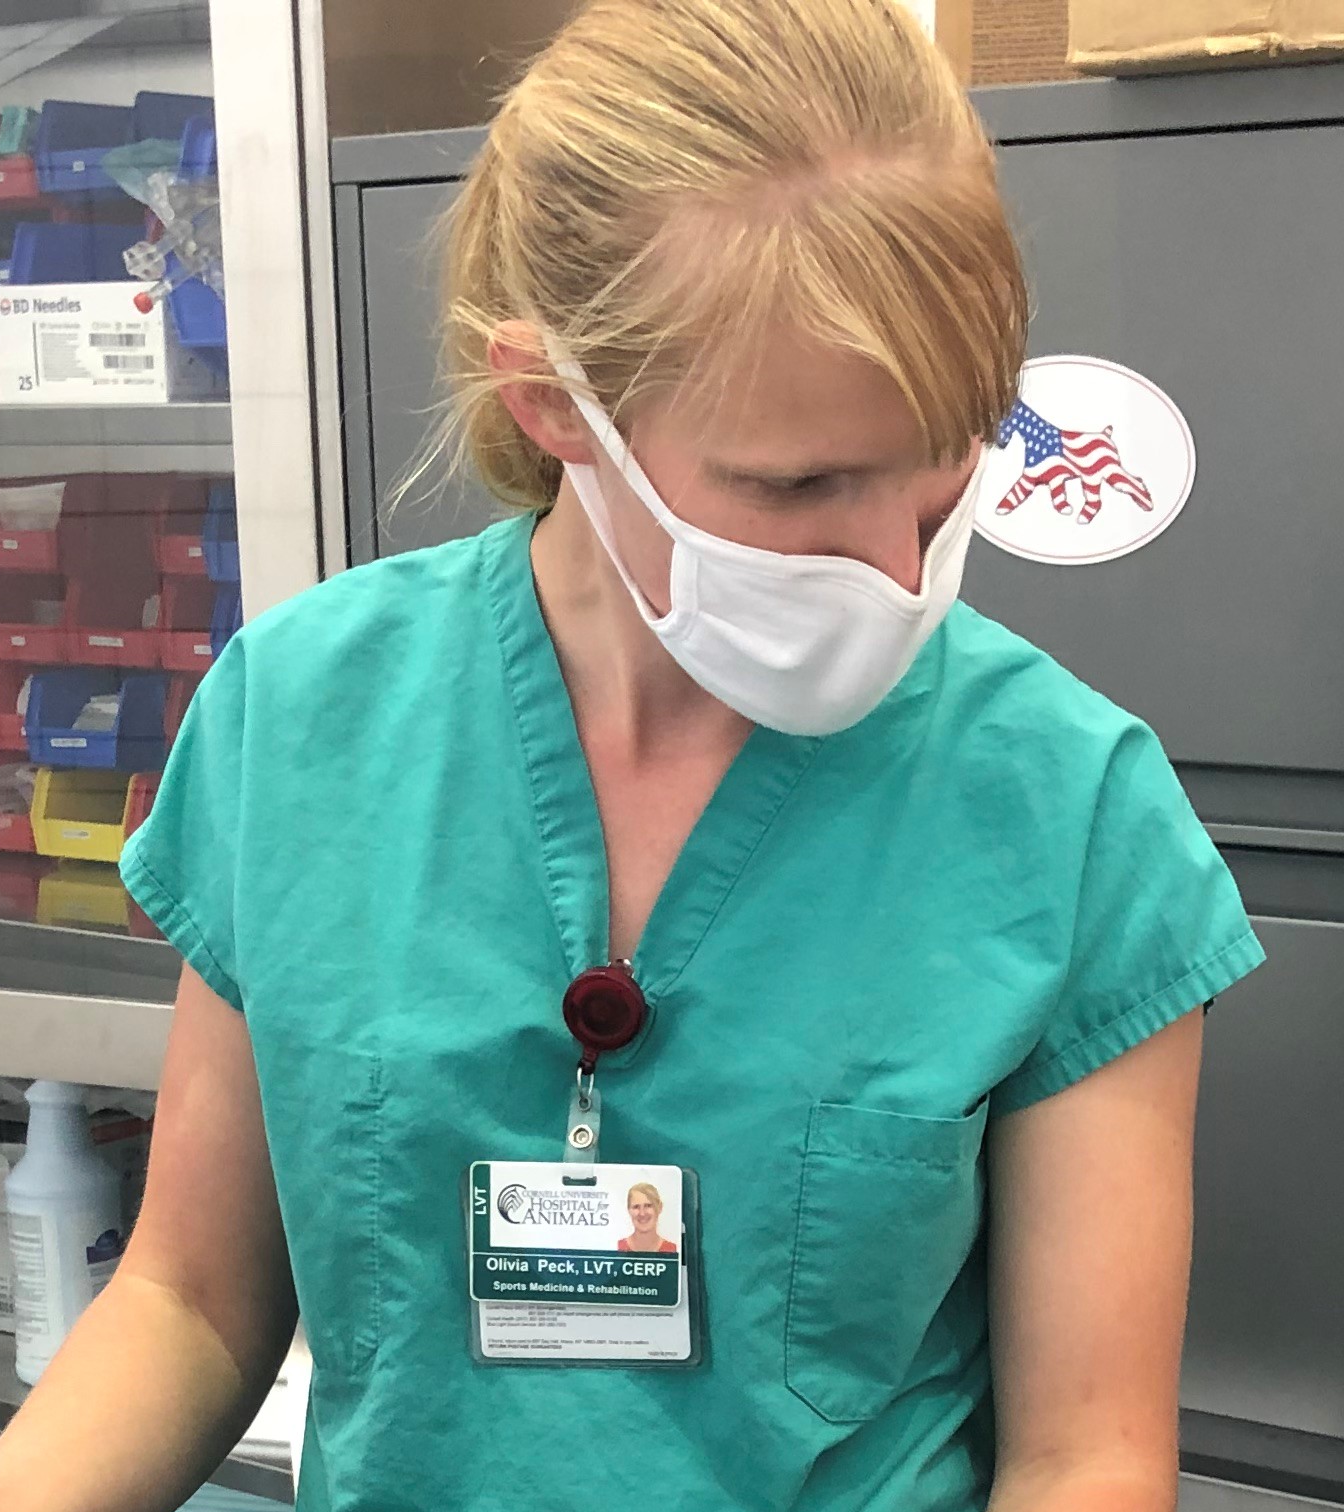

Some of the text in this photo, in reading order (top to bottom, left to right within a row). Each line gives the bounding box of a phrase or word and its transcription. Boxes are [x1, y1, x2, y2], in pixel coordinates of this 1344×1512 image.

[12, 297, 82, 315] BD Needles
[18, 376, 34, 392] 25
[474, 1186, 488, 1216] LVT
[561, 1190, 610, 1200] UNIVERSITY
[531, 1197, 595, 1213] HOSPITAL
[522, 1208, 610, 1227] ANIMALS
[486, 1257, 667, 1277] Olivia Peck, LVT, CERP
[492, 1280, 658, 1297] Sports Medicine & Rehabilitation
